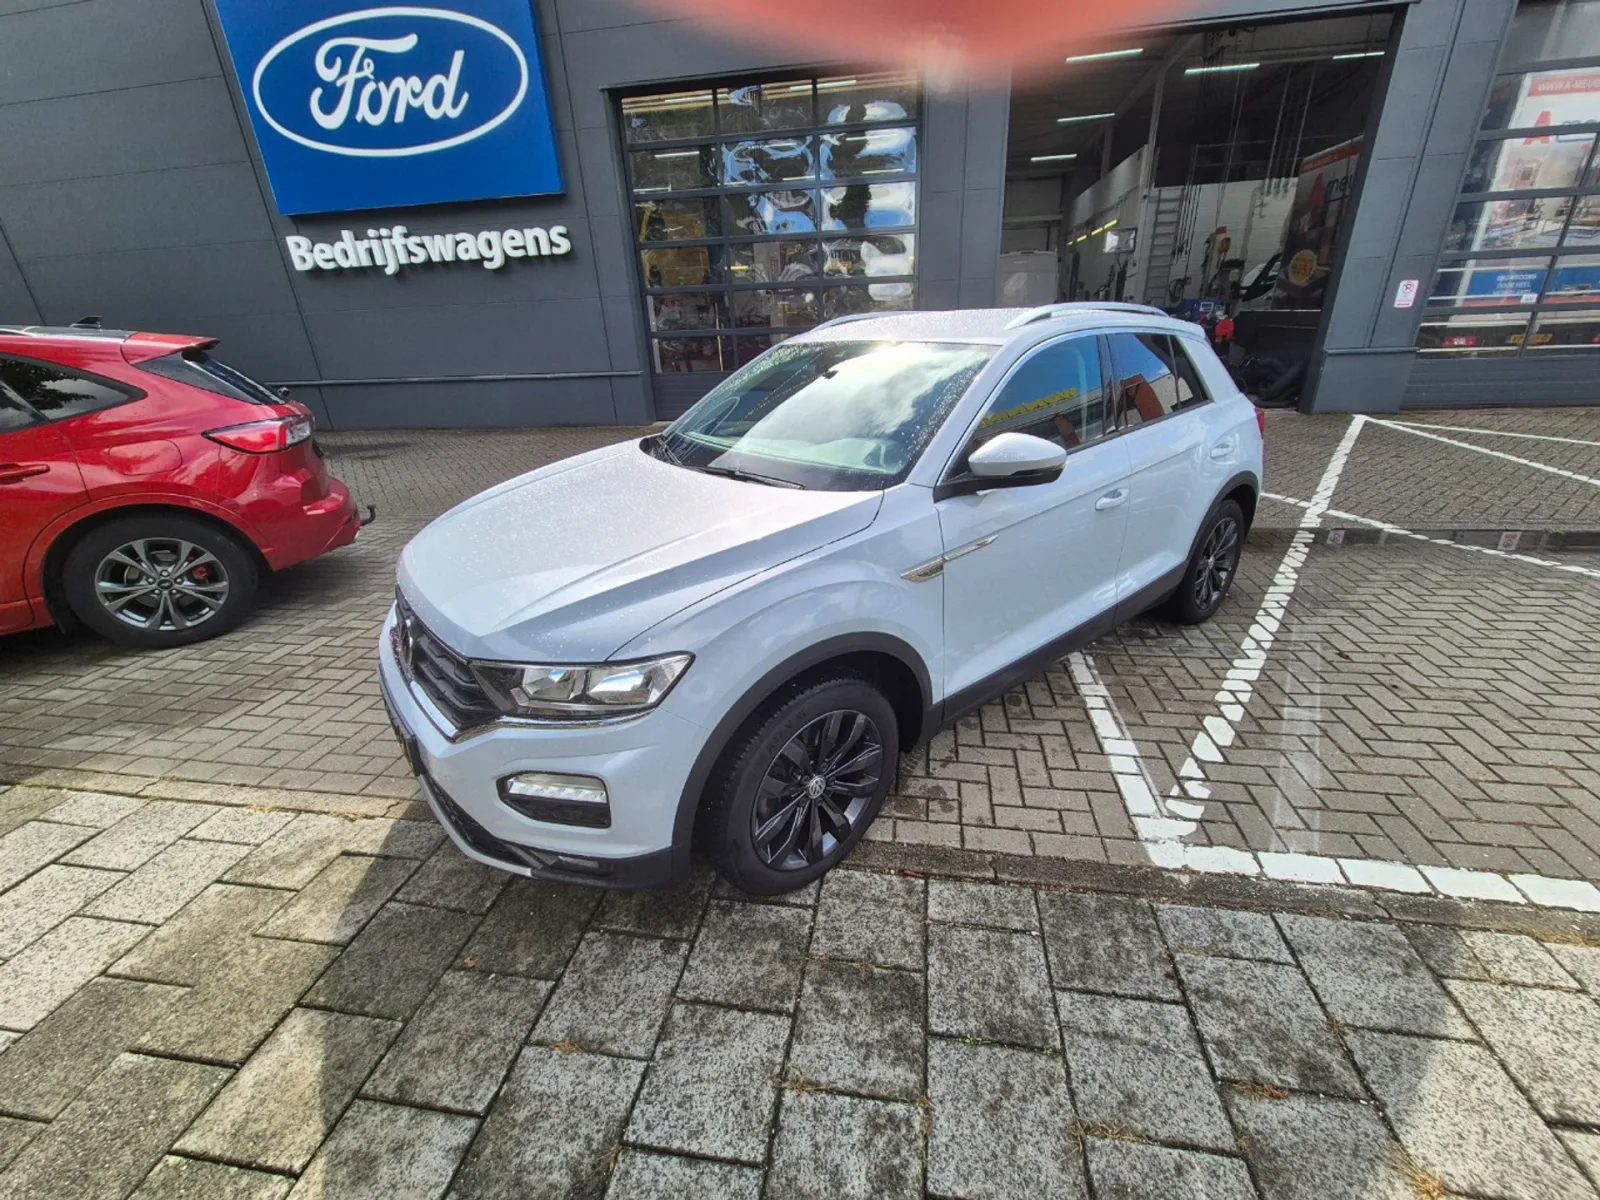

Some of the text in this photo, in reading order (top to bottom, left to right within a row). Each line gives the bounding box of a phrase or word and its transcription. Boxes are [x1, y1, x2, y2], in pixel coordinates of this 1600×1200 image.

[309, 33, 470, 131] Ford
[1523, 110, 1550, 145] A
[286, 225, 572, 275] Bedrijfswagens
